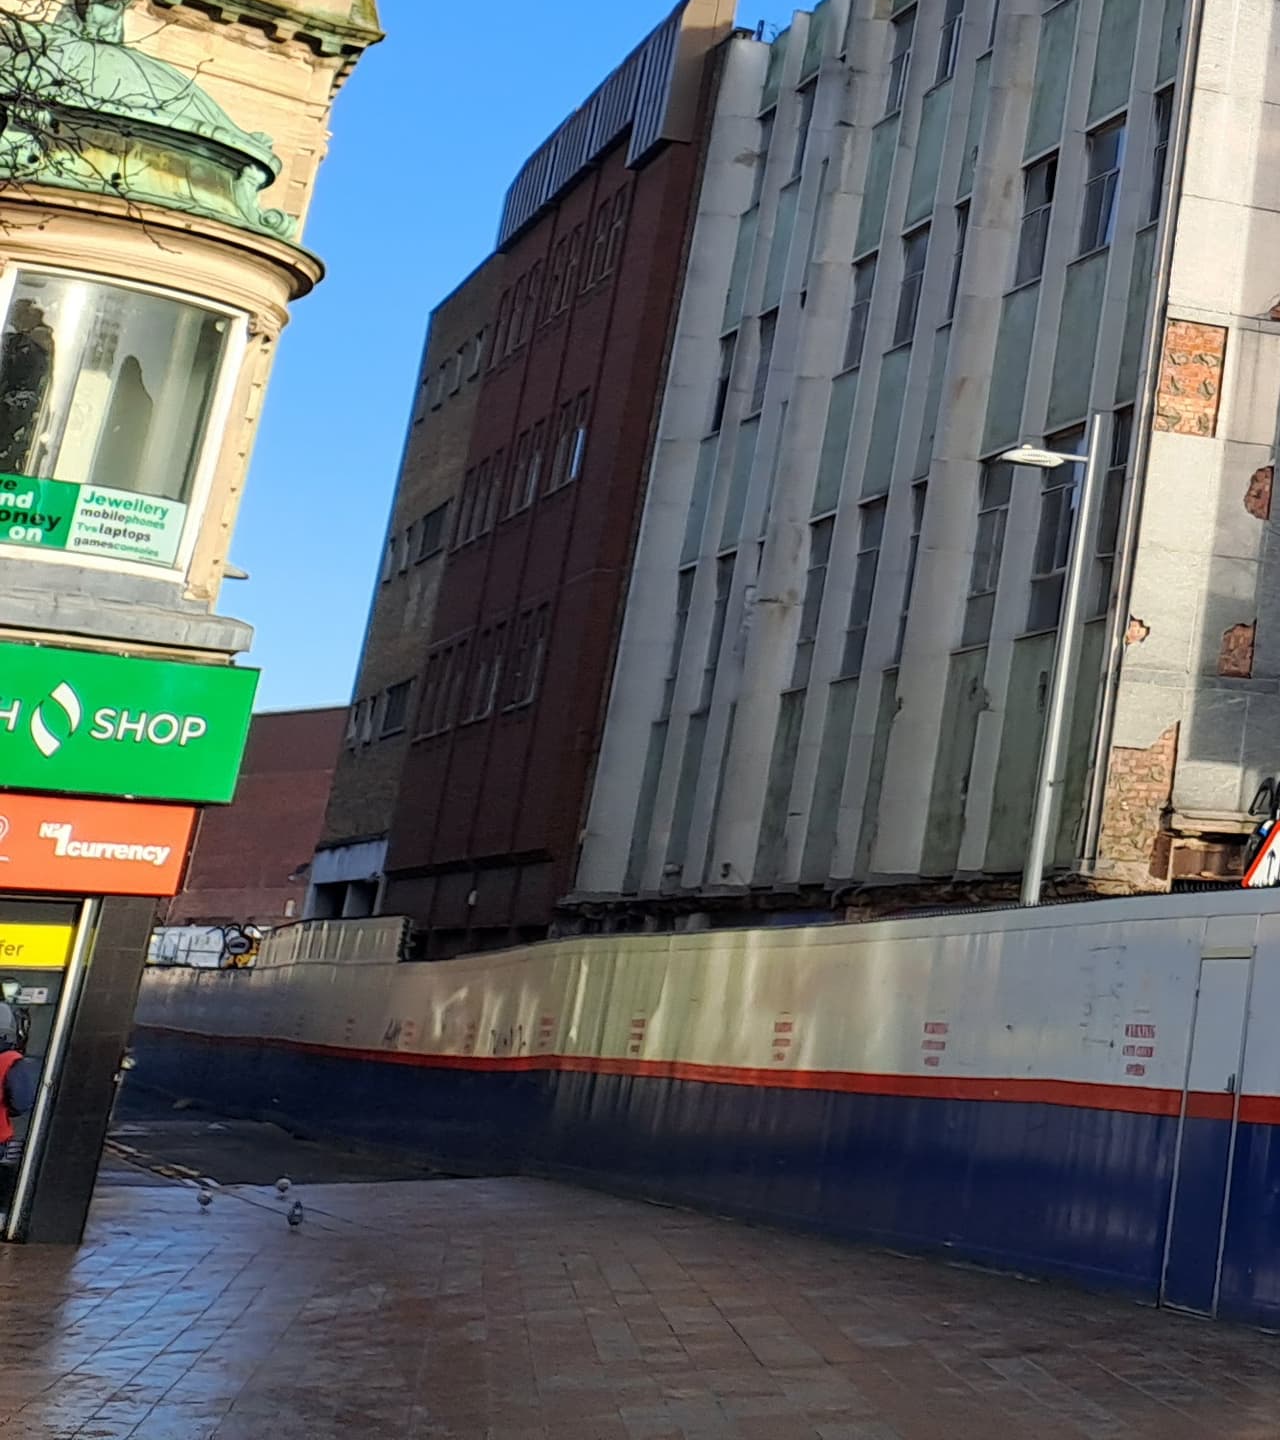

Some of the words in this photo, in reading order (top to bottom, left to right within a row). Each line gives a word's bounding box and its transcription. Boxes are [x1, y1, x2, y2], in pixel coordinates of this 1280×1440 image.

[83, 491, 169, 520] Jewellery
[8, 525, 43, 543] on
[89, 707, 207, 747] SHOP
